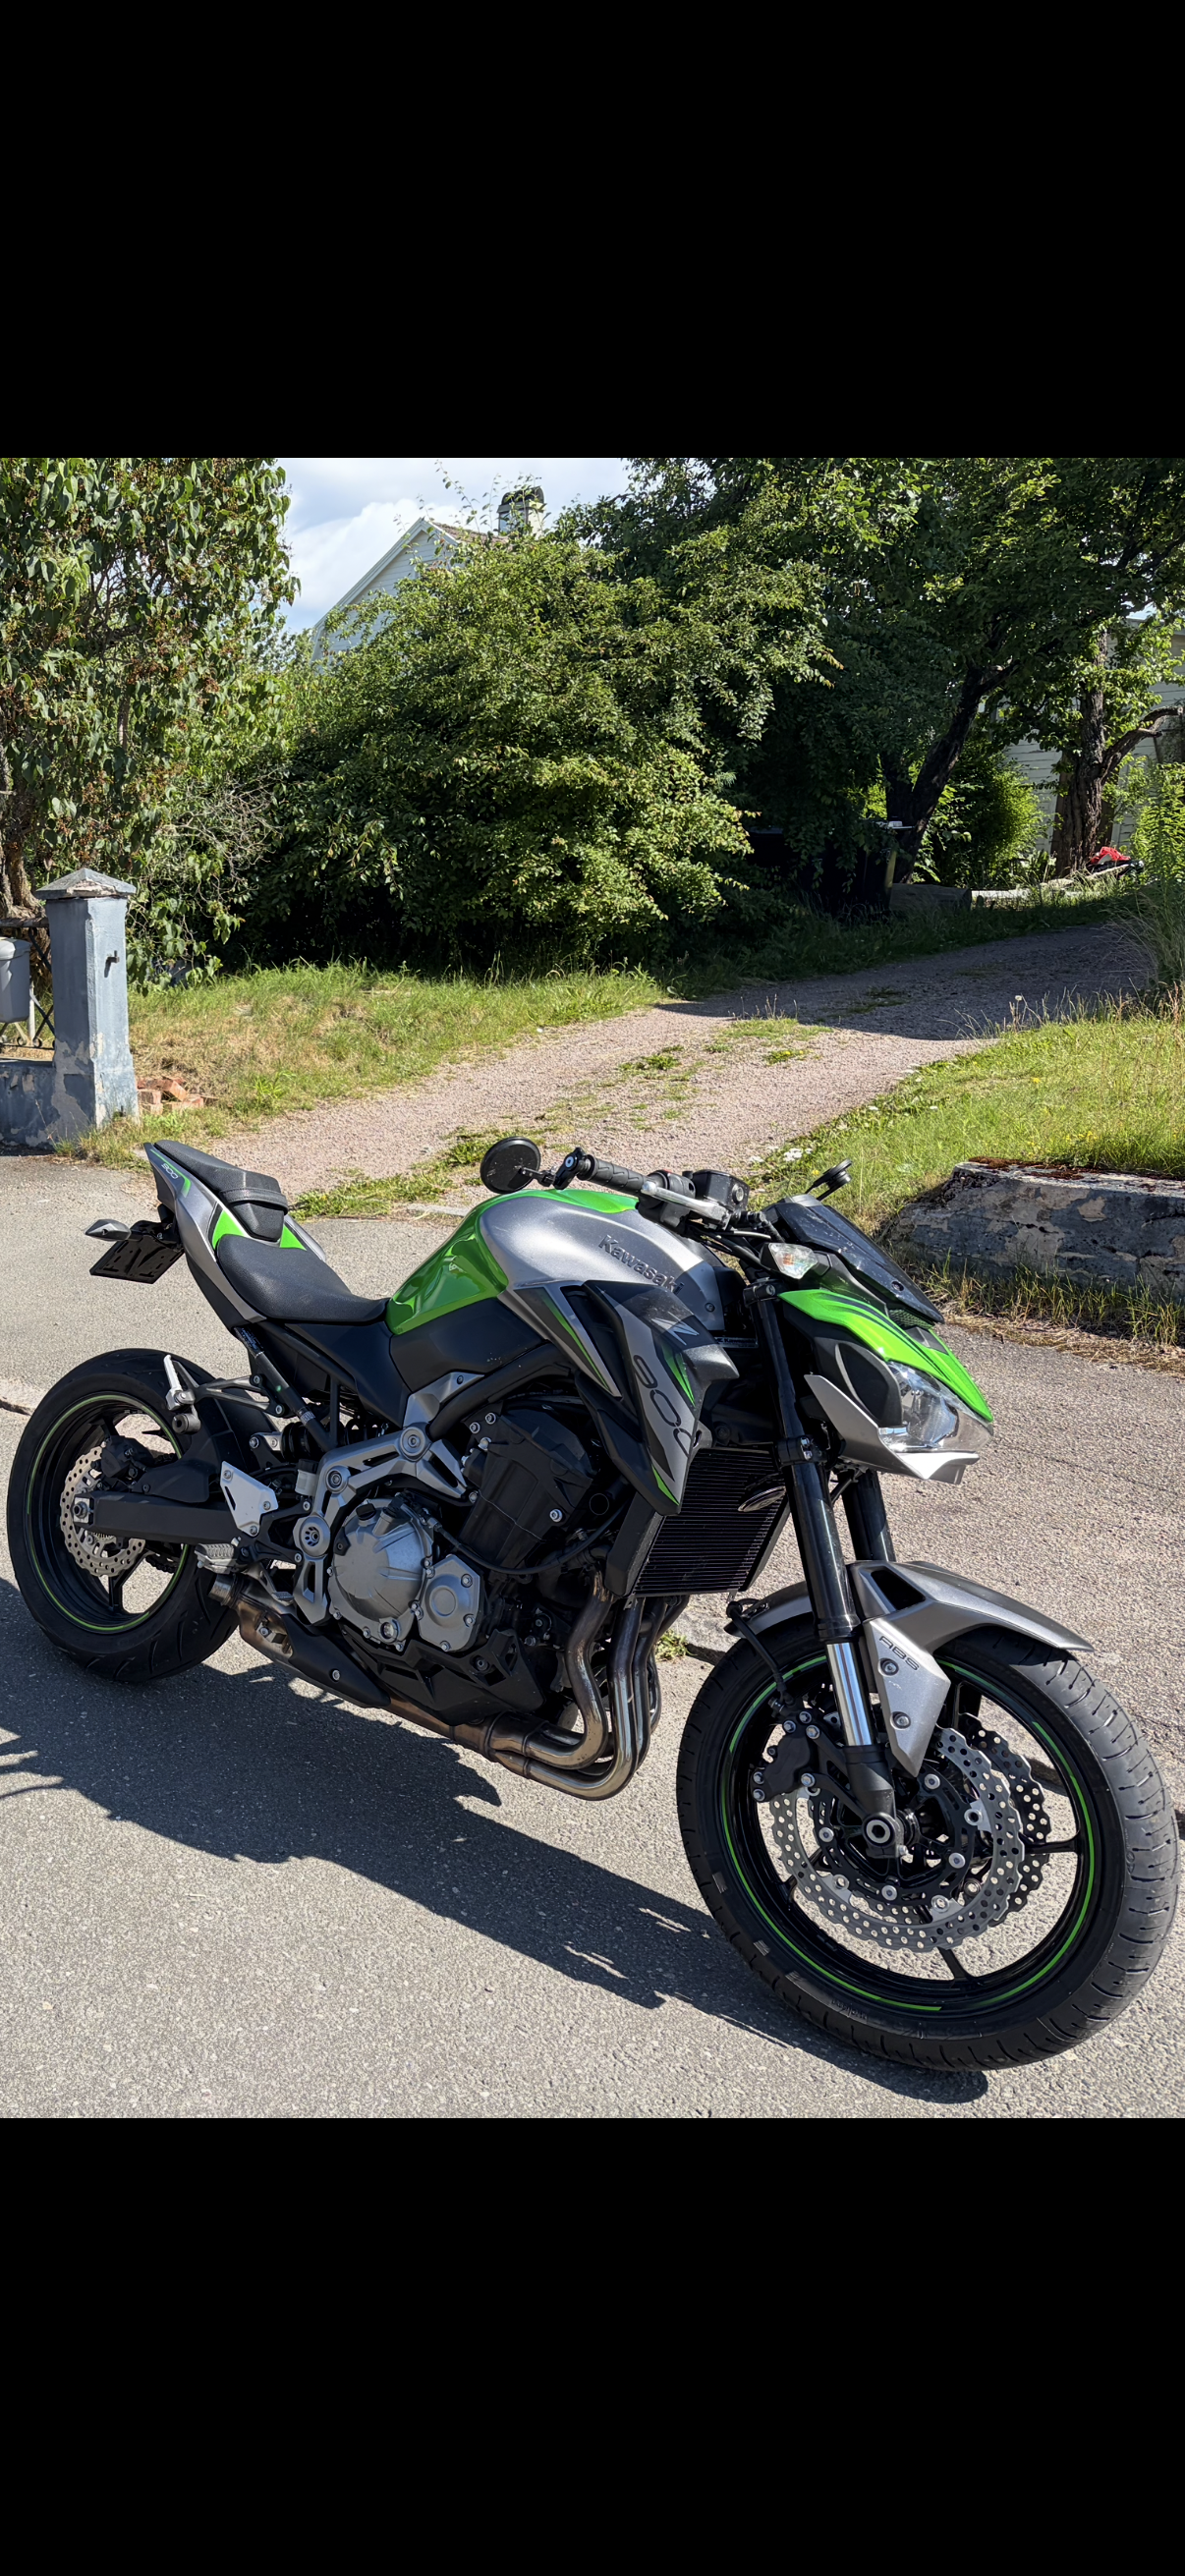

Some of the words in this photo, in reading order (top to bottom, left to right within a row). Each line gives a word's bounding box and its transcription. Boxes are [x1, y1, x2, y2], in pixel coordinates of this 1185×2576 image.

[161, 1162, 179, 1180] 900
[598, 1234, 685, 1295] Kawasaki
[878, 1635, 920, 1671] ABS
